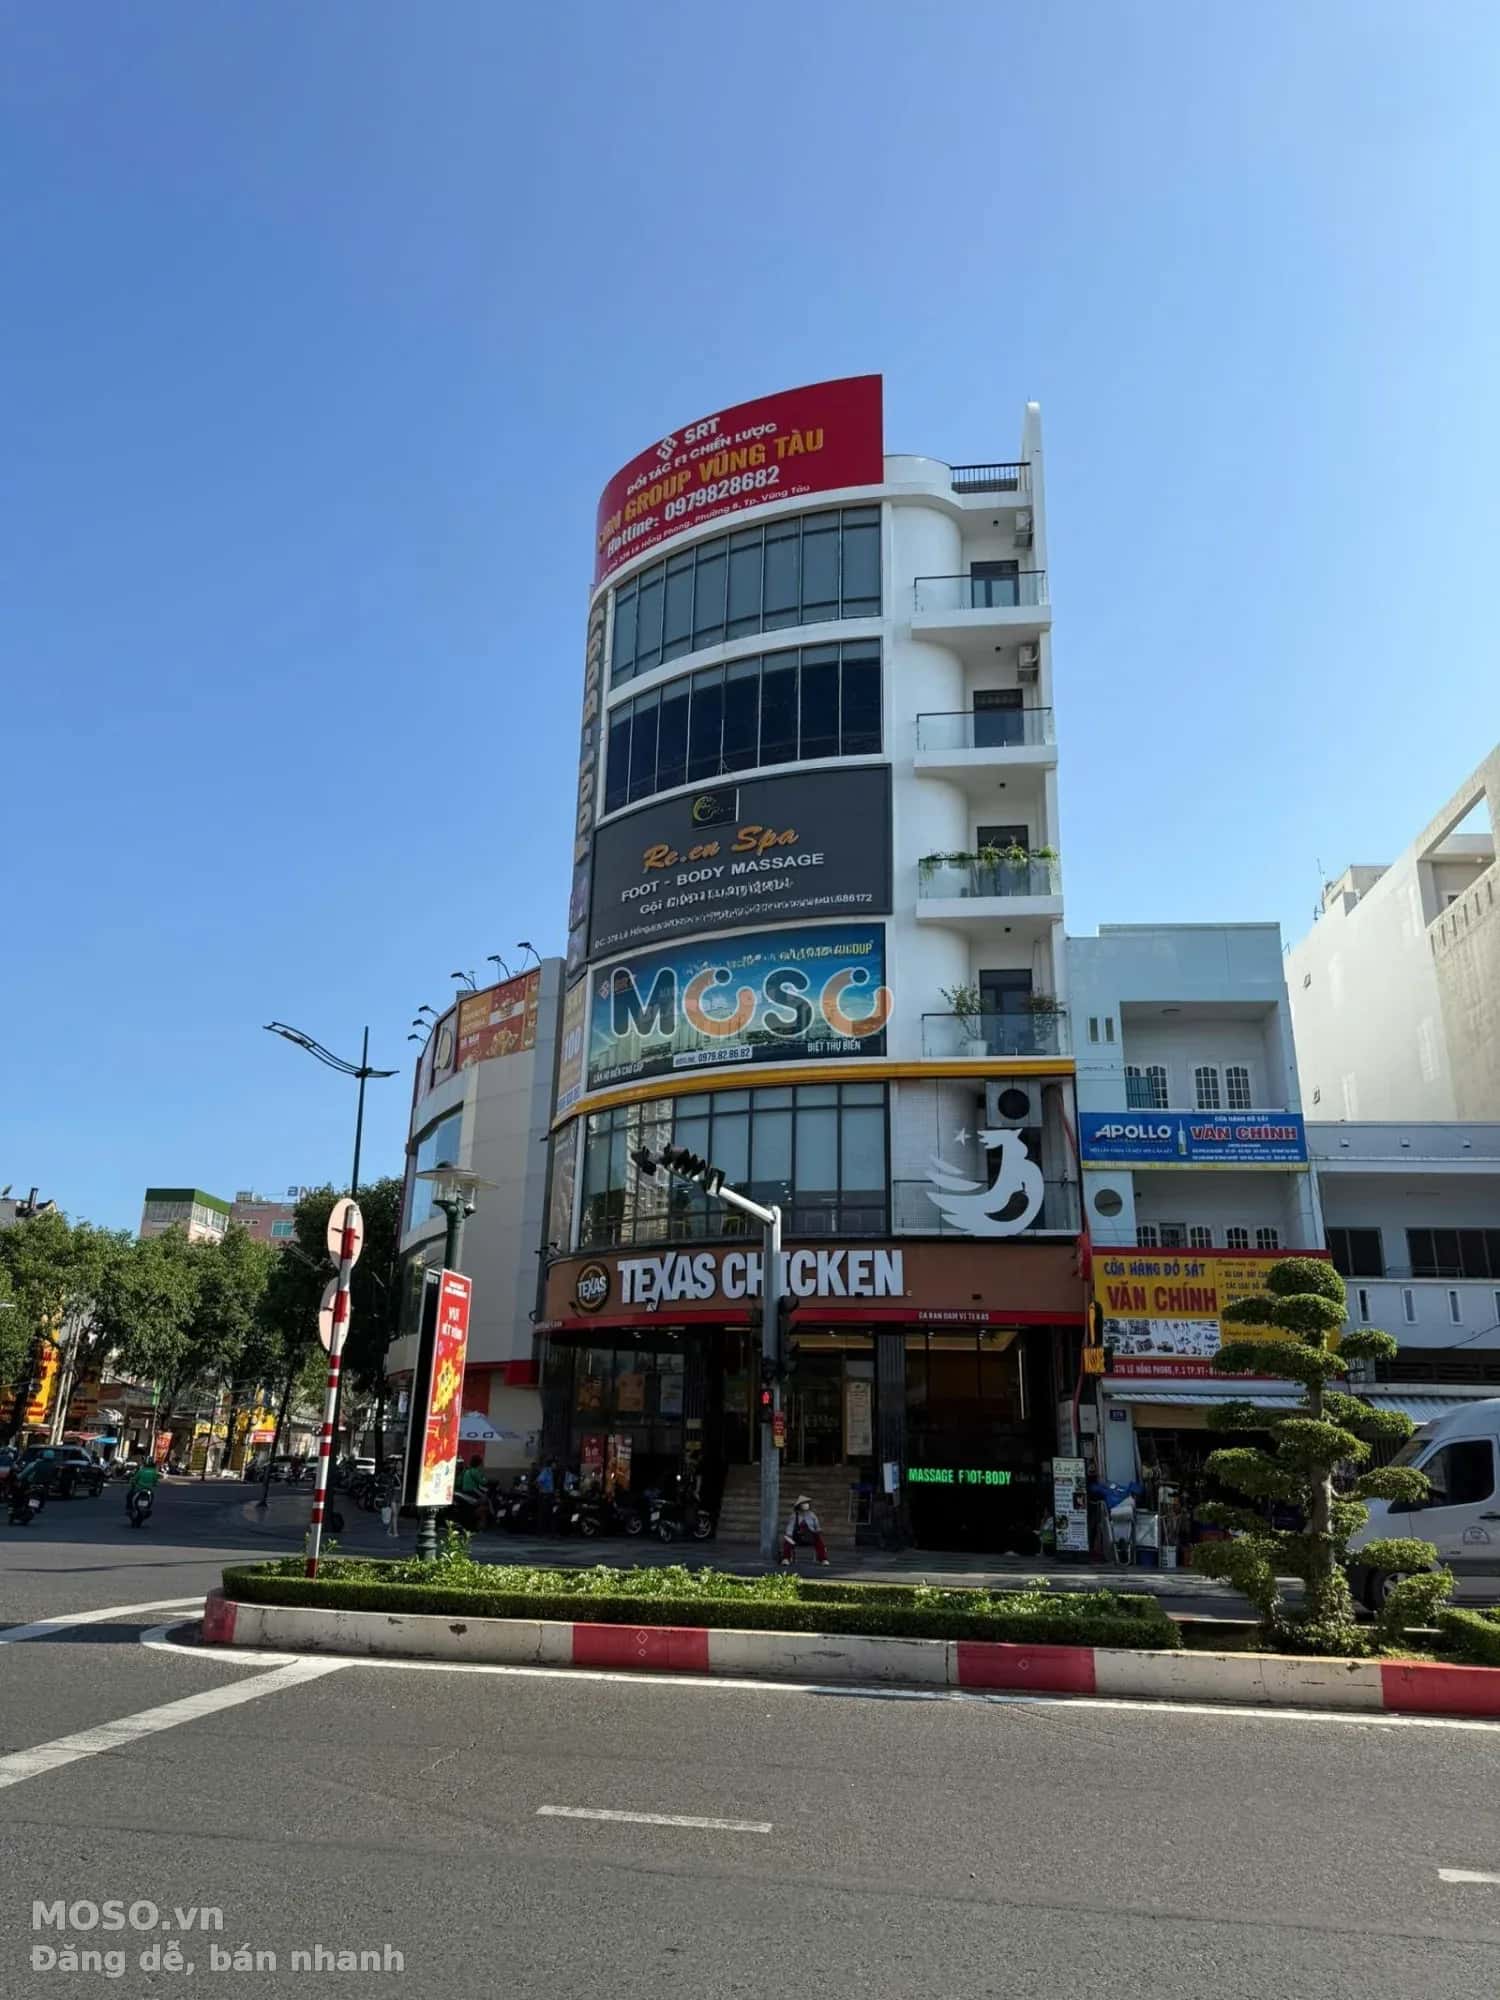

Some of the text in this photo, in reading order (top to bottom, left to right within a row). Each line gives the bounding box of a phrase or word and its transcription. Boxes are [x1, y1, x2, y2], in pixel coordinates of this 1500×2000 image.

[684, 416, 721, 445] SRT
[649, 461, 672, 481] TÁC
[689, 432, 731, 460] CHIẾN
[735, 422, 778, 443] LƯỢC
[624, 469, 691, 522] GROUP
[699, 442, 767, 484] VŨNG
[773, 427, 824, 460] TÀU
[664, 464, 780, 523] 0979828682
[761, 488, 789, 502] Vũng
[791, 484, 811, 495] Tàu
[731, 825, 800, 857] Spa
[621, 880, 660, 903] FOOT
[676, 865, 725, 886] BODY
[731, 852, 825, 876] MASSAGE
[1095, 1123, 1172, 1139] APOLLO
[1190, 1123, 1297, 1141] VĂN CHÍNH
[617, 1251, 717, 1312] TEXAS
[1103, 1257, 1126, 1276] CỬA
[1129, 1258, 1161, 1276] HÀNG
[1163, 1257, 1181, 1277] ĐỒ
[1184, 1257, 1206, 1277] SẮT
[577, 1275, 608, 1300] TEXAS
[1105, 1280, 1218, 1313] VĂN CHÍNH
[908, 1467, 954, 1483] MASSAGE
